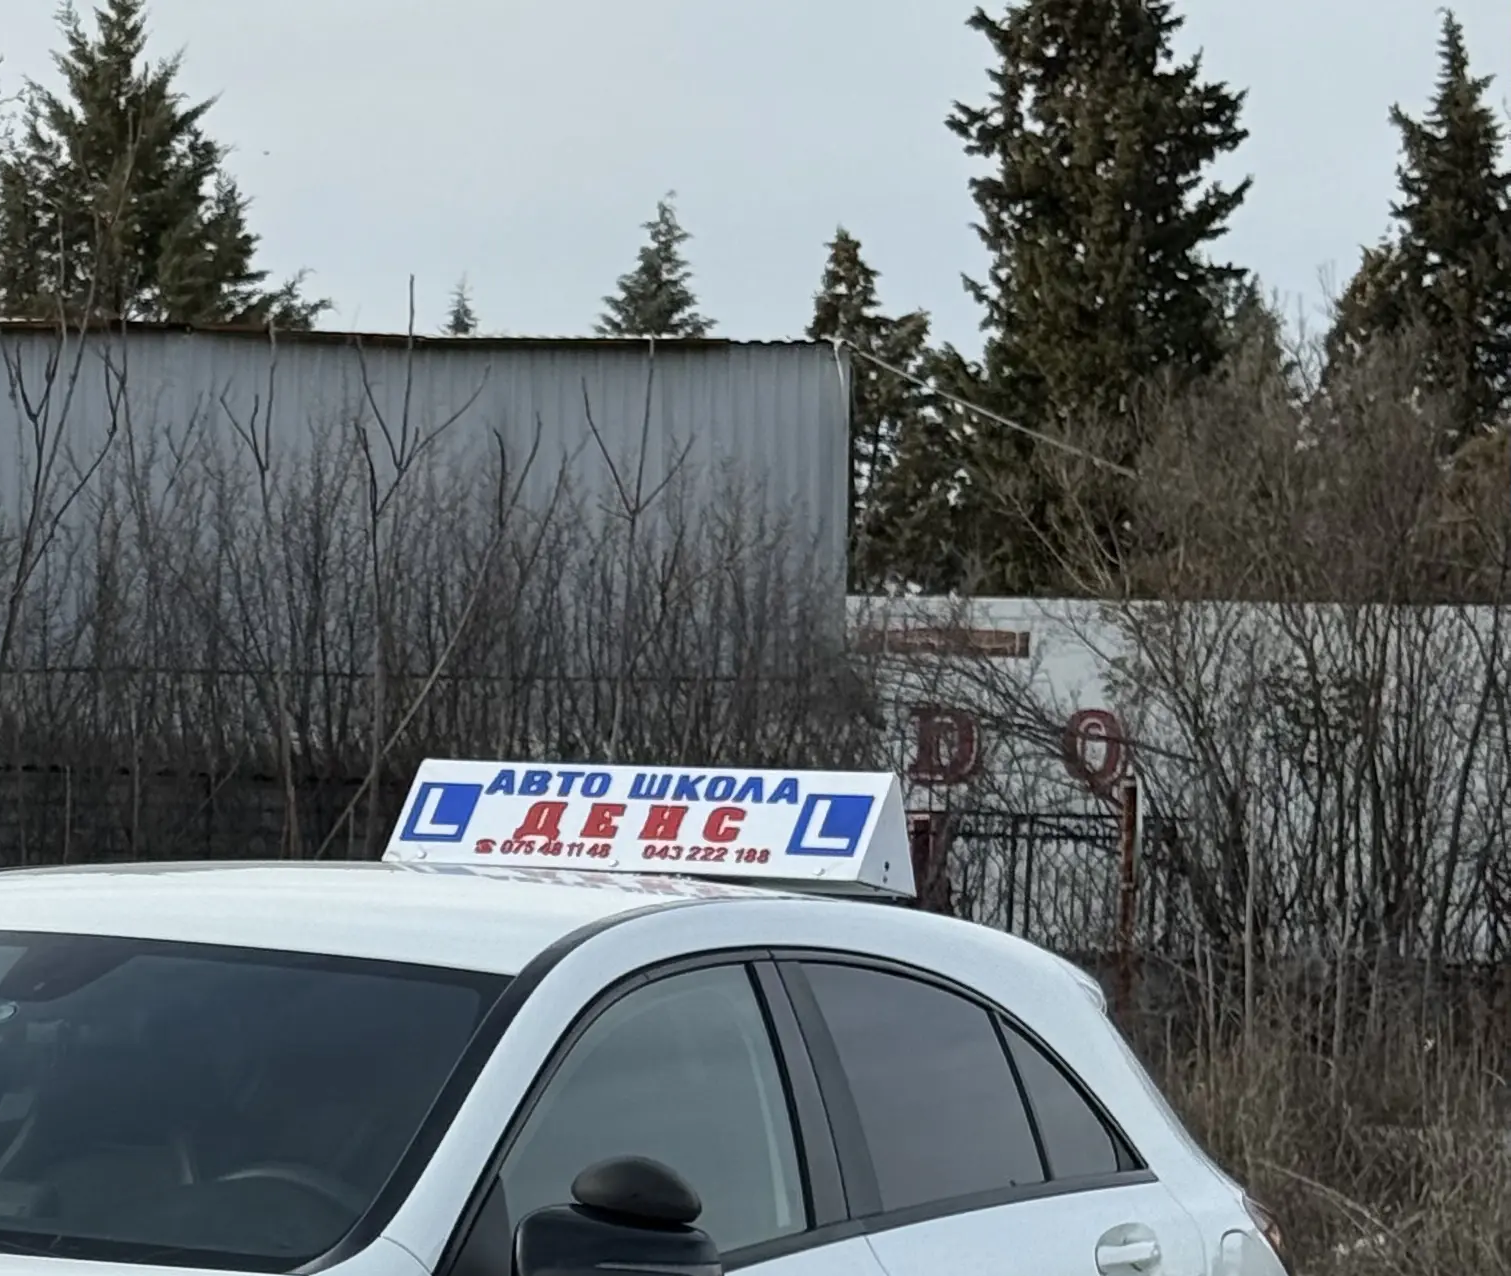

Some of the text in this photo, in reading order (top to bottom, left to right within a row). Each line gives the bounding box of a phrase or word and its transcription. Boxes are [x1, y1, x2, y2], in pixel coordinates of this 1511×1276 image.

[485, 769, 800, 804] АВТО ШКОЛА
[512, 801, 747, 843] ДЕНС
[642, 844, 770, 864] 043 222 188
